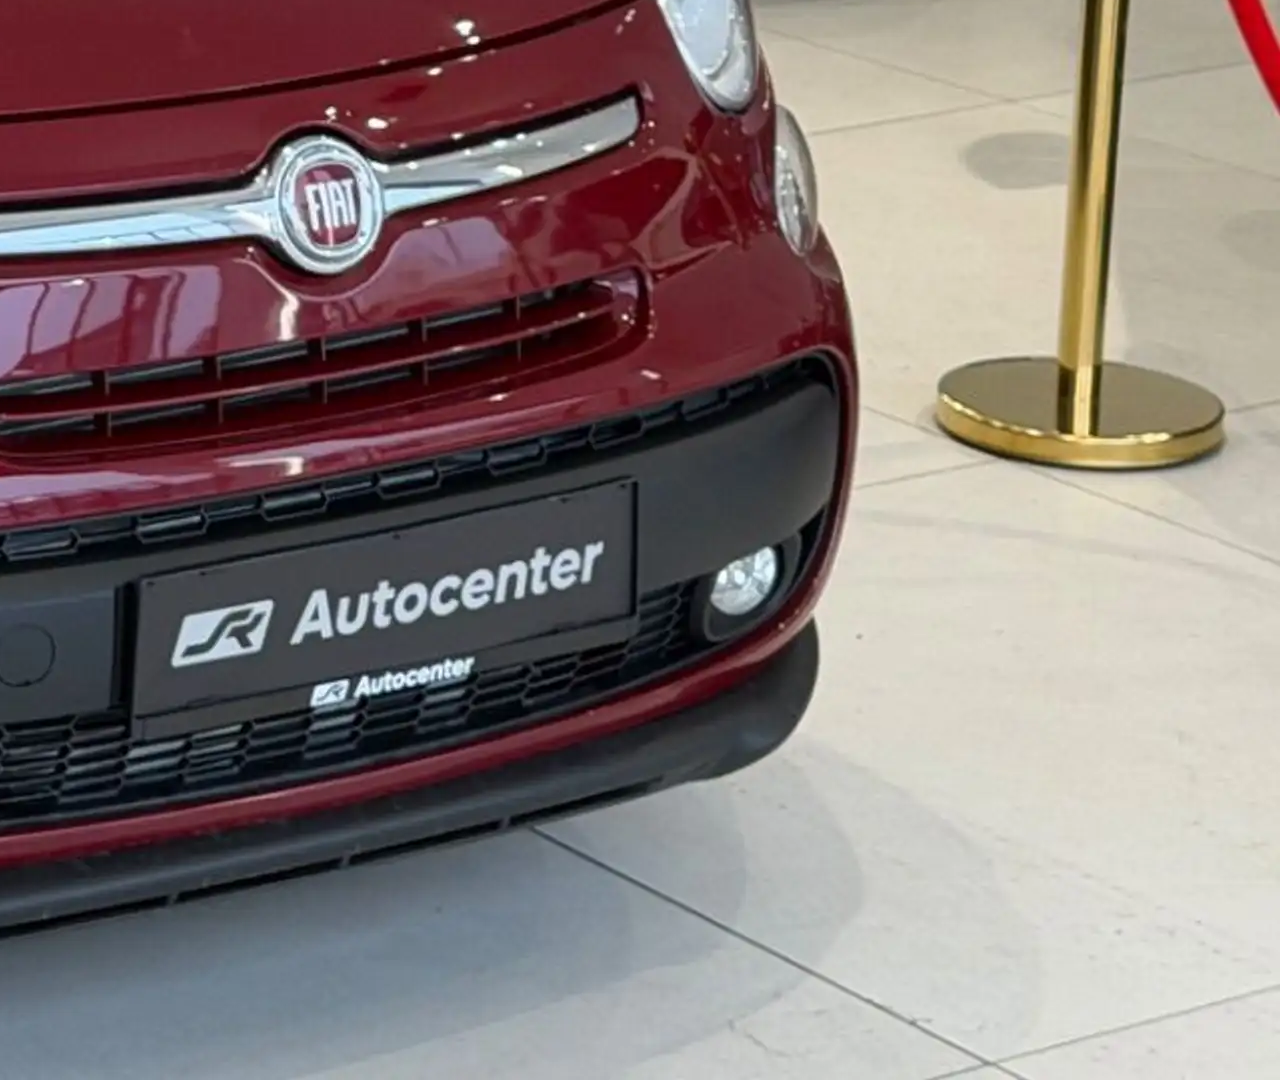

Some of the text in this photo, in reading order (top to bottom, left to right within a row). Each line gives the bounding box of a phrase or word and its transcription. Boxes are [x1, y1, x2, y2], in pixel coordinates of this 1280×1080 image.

[304, 178, 357, 232] FIAT
[290, 541, 604, 646] Autocenter
[353, 656, 475, 698] Autocenter
